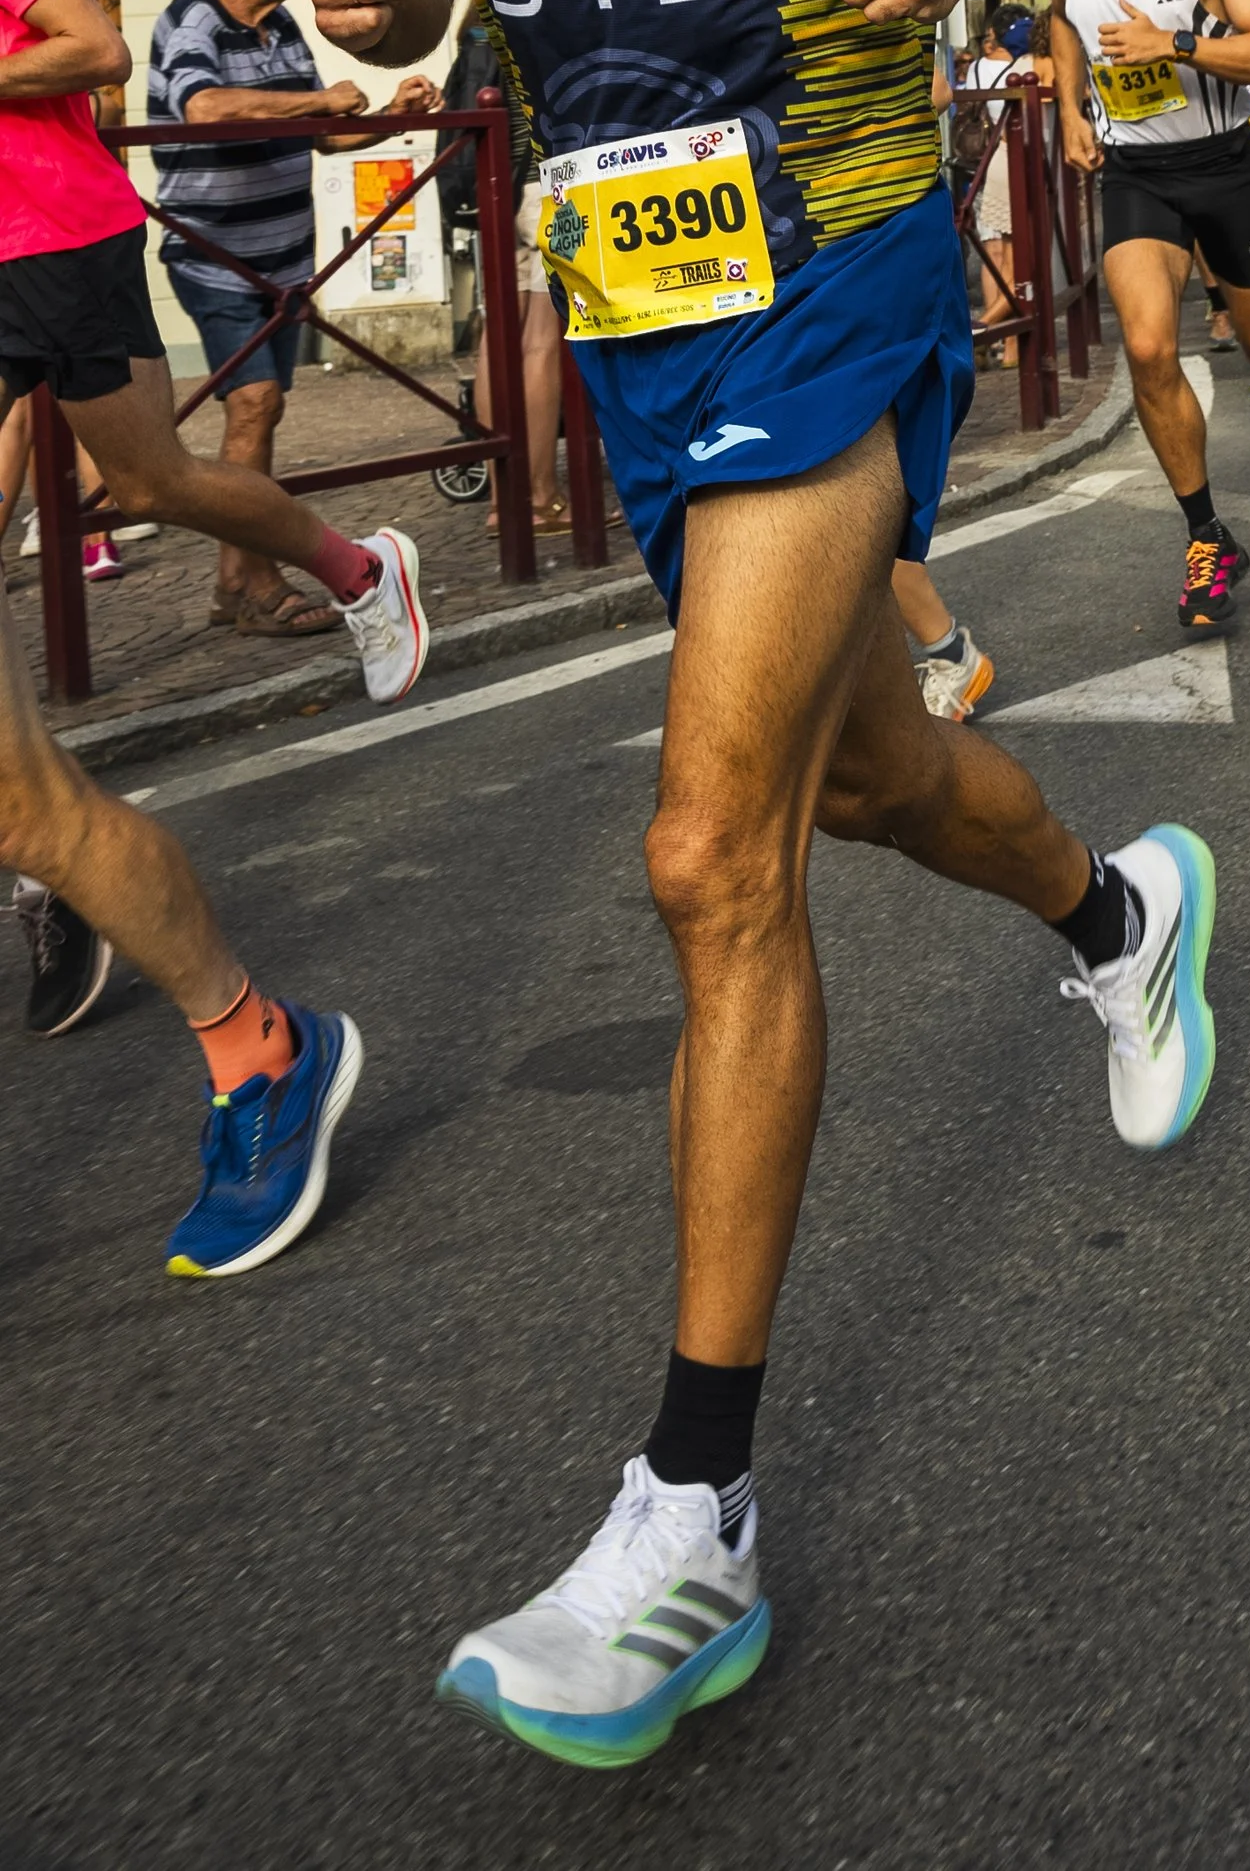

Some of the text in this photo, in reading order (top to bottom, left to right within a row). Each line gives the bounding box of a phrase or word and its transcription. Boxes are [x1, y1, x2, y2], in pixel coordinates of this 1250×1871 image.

[1118, 61, 1173, 92] 3314
[545, 215, 589, 238] CINQUE
[610, 182, 747, 253] 3390
[549, 232, 586, 254] LAGHI
[679, 261, 722, 285] TRAILS
